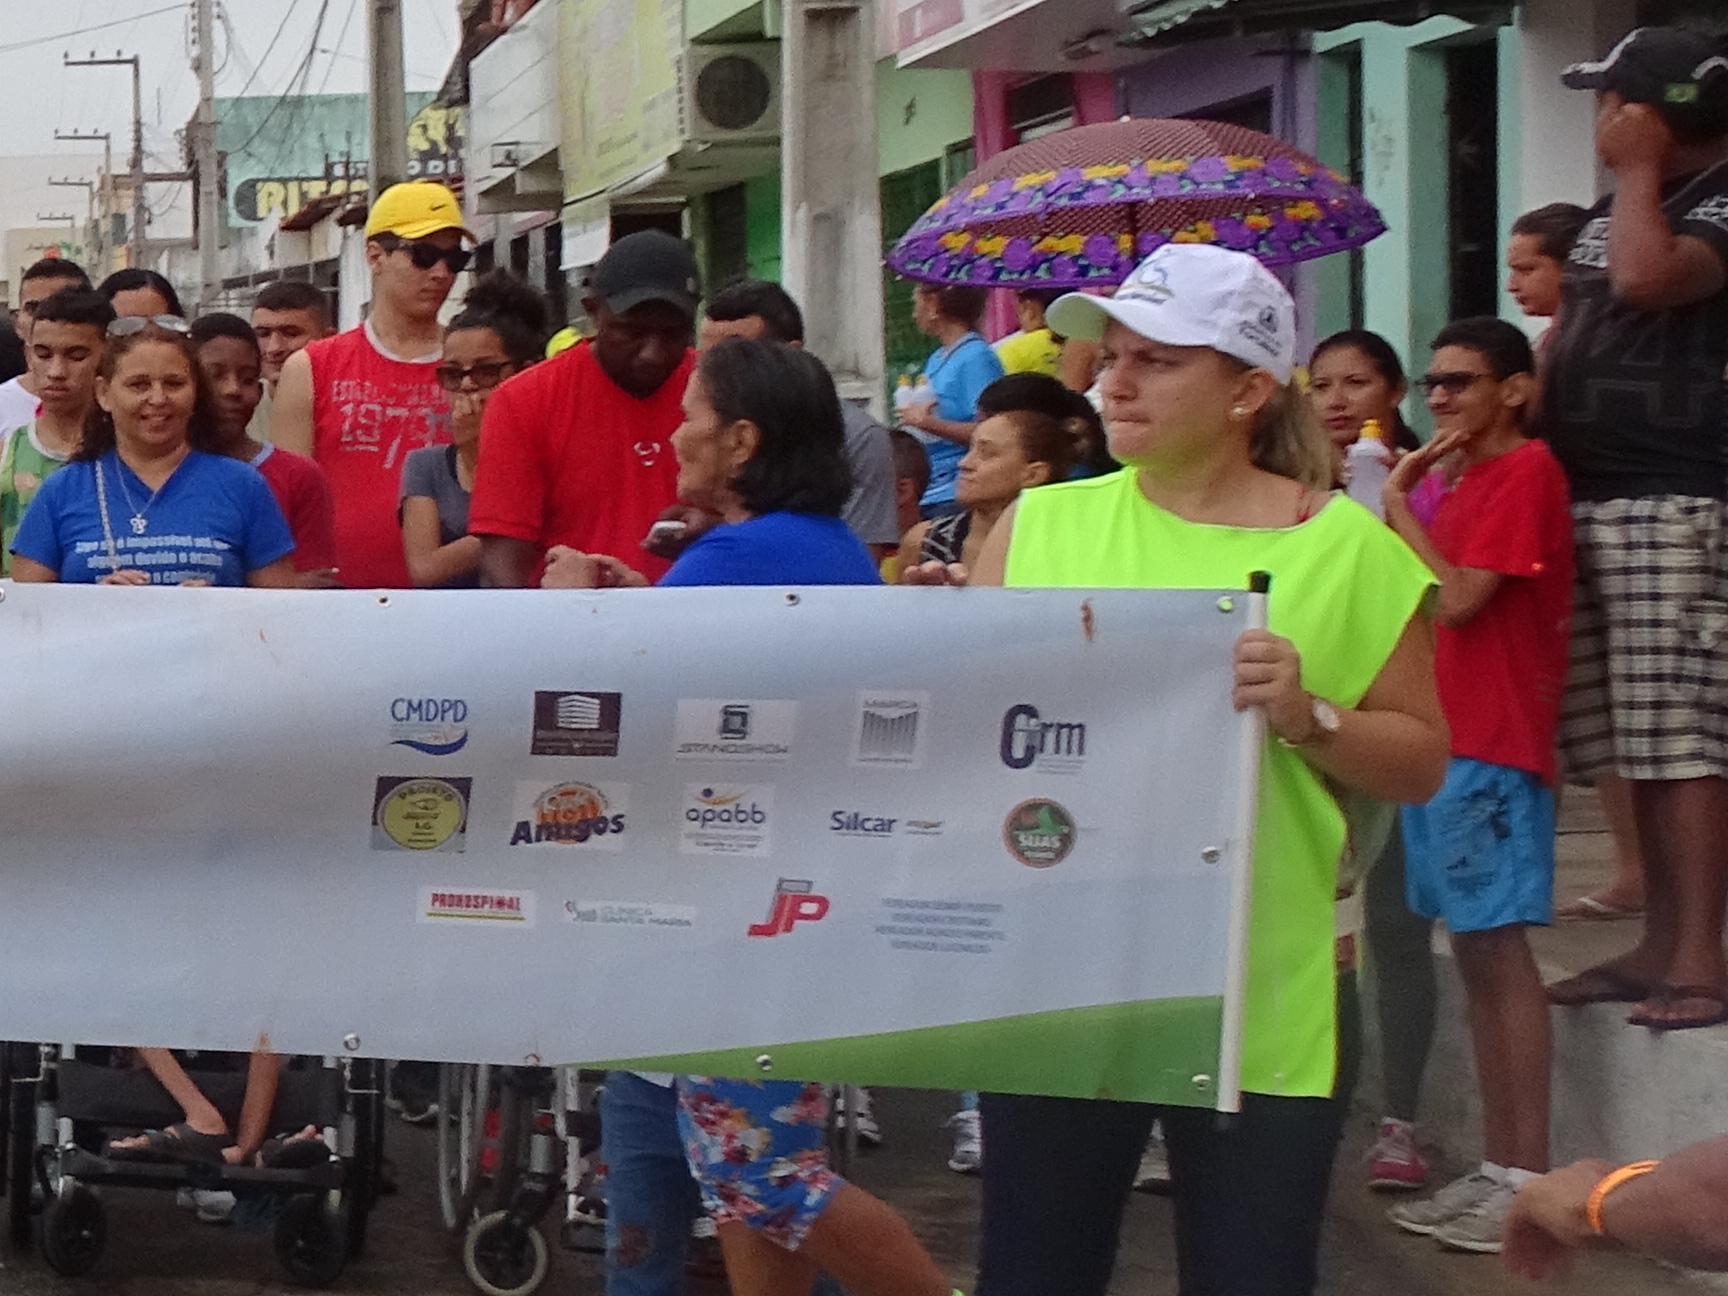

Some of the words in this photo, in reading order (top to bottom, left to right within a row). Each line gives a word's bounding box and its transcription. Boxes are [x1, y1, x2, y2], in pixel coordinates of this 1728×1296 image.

[390, 697, 468, 723] CMDPD
[685, 803, 767, 830] apabb
[829, 809, 898, 834] Silcar
